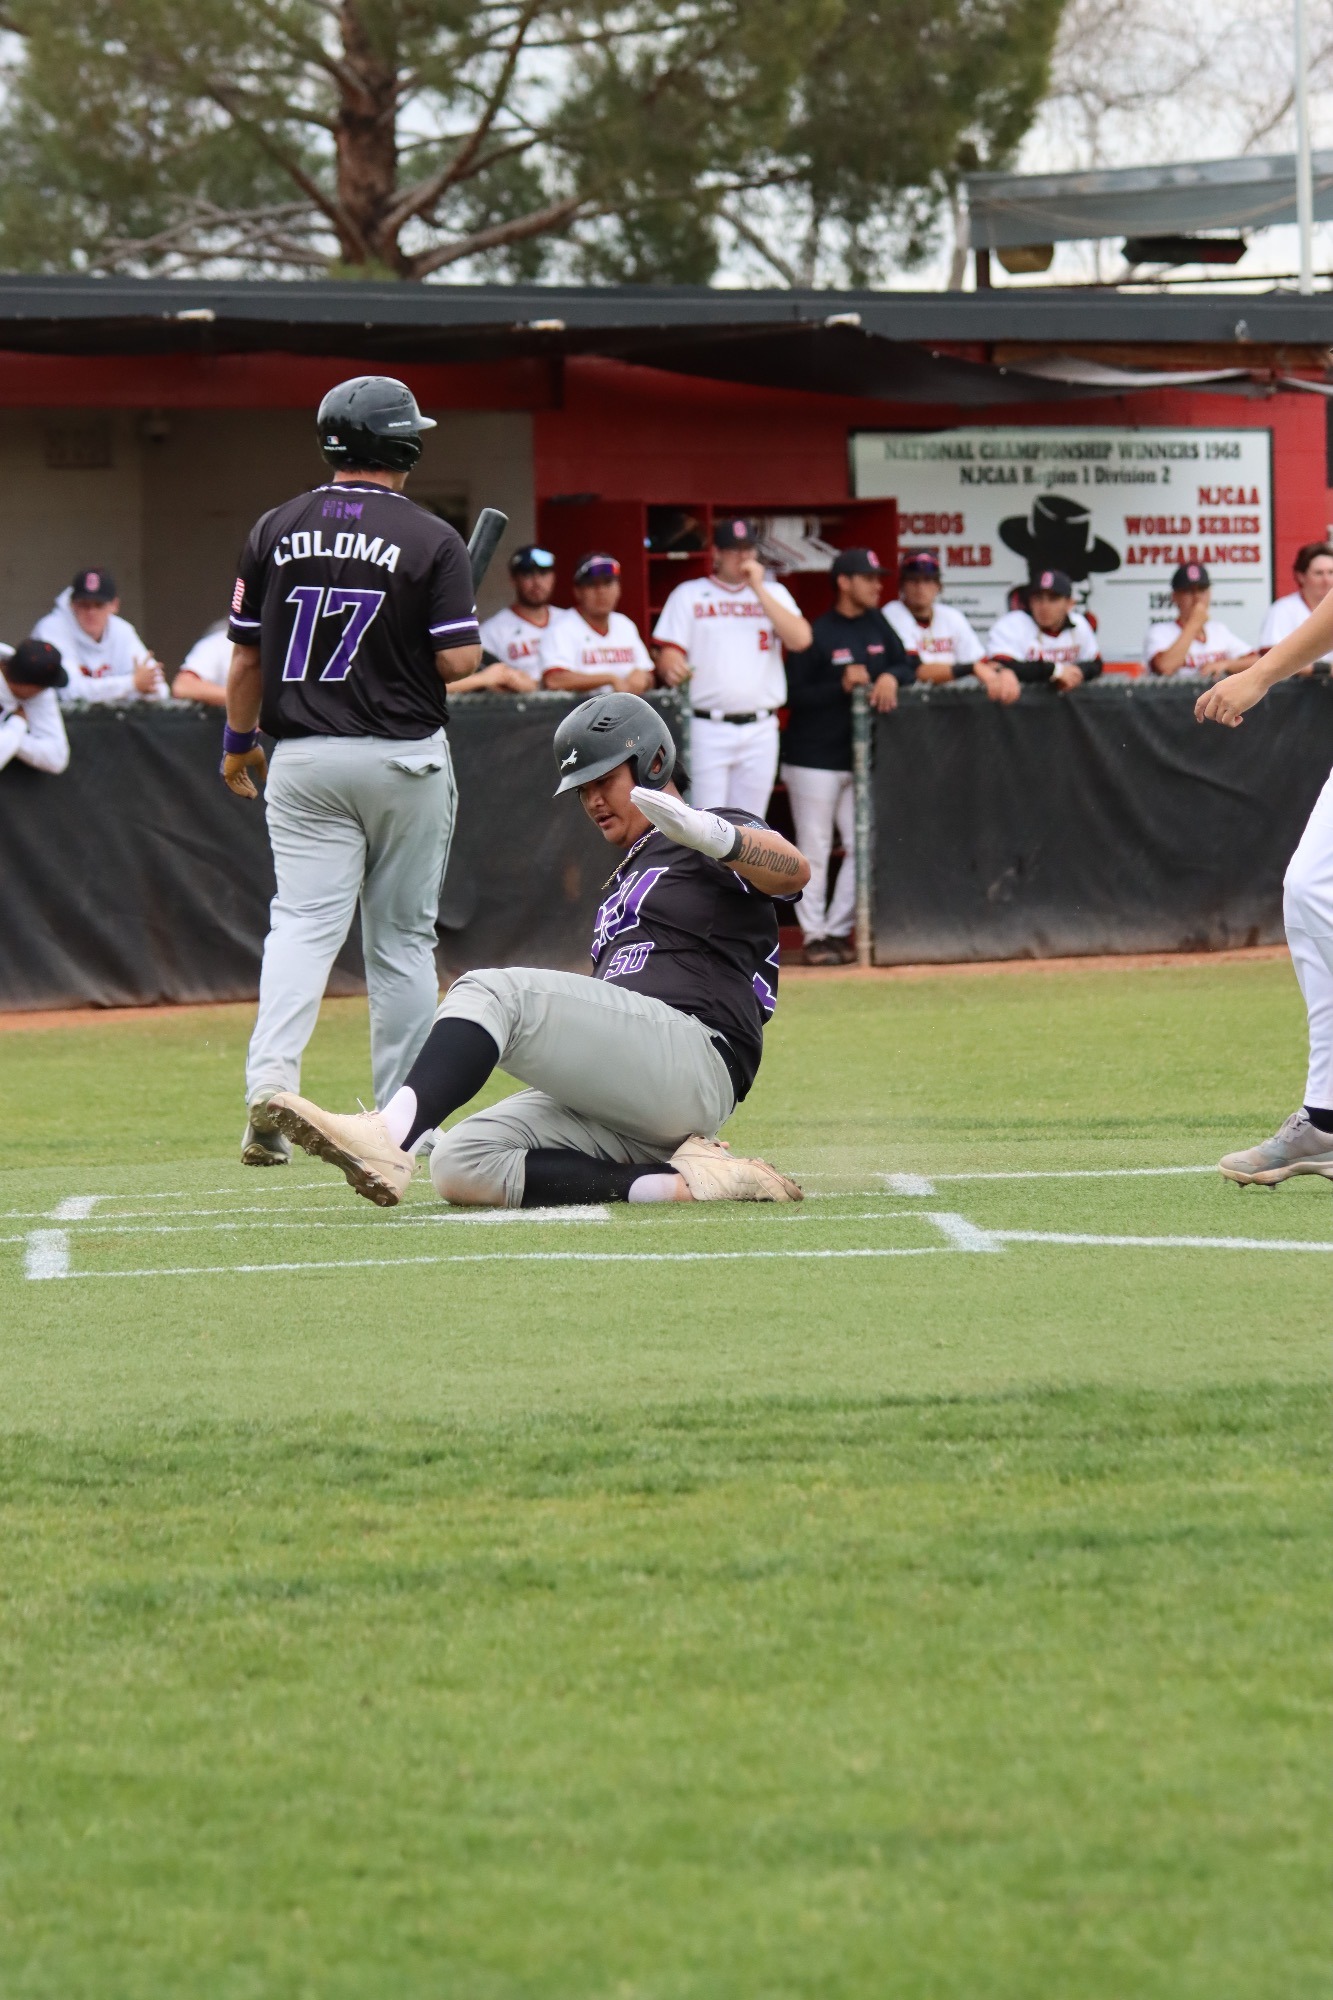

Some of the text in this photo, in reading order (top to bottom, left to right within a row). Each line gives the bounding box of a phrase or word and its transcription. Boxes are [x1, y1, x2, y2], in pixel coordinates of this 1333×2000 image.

[1119, 441, 1199, 460] WINNERS
[1205, 441, 1241, 460] 1968
[960, 466, 1018, 485] NJCAA
[1094, 466, 1156, 484] Division
[1161, 466, 1170, 484] 2
[1197, 486, 1260, 505] NJCAA
[897, 512, 964, 535] UCHOS
[1124, 515, 1260, 535] WORLD SERIES
[273, 530, 401, 574] COLOMA
[946, 545, 991, 567] MLB
[1125, 544, 1261, 565] APPEARANCES
[281, 586, 386, 682] 17
[758, 630, 769, 651] 2
[603, 942, 655, 981] 50
